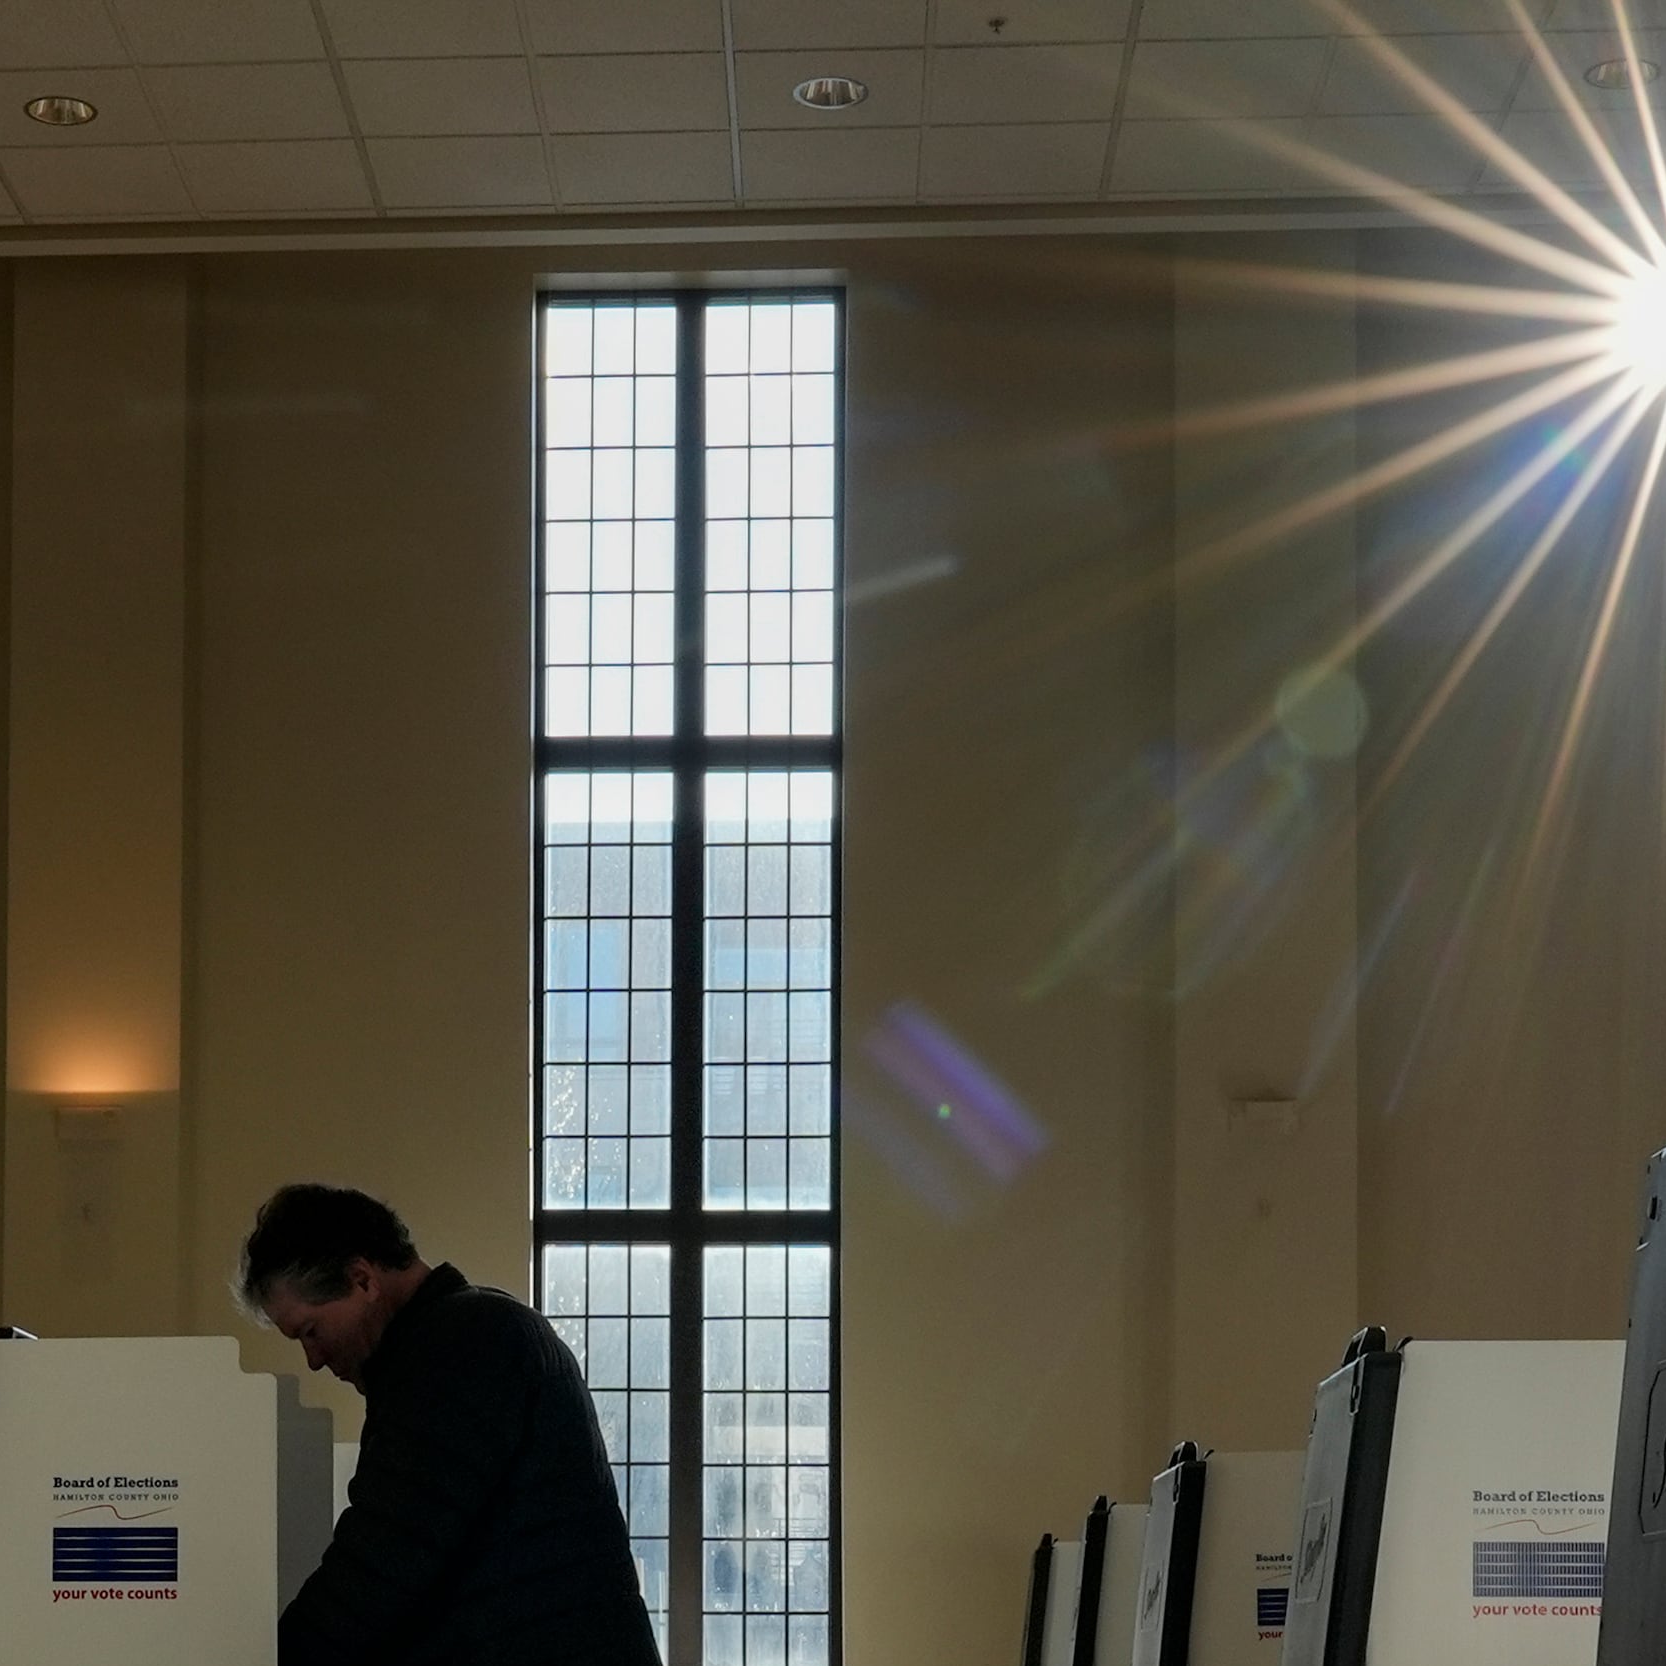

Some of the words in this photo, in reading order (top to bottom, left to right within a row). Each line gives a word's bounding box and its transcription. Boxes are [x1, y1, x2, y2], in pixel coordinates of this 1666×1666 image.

[53, 1477, 94, 1488] Board
[97, 1477, 111, 1488] of
[114, 1477, 178, 1488] Elections
[1473, 1491, 1516, 1501] Board
[1519, 1491, 1534, 1501] of
[1536, 1491, 1605, 1502] Elections
[1256, 1553, 1285, 1562] Board
[53, 1589, 87, 1602] your
[91, 1588, 123, 1599] vote
[128, 1588, 177, 1599] counts
[1473, 1605, 1509, 1618] your
[1513, 1605, 1547, 1615] vote
[1258, 1631, 1283, 1640] your
